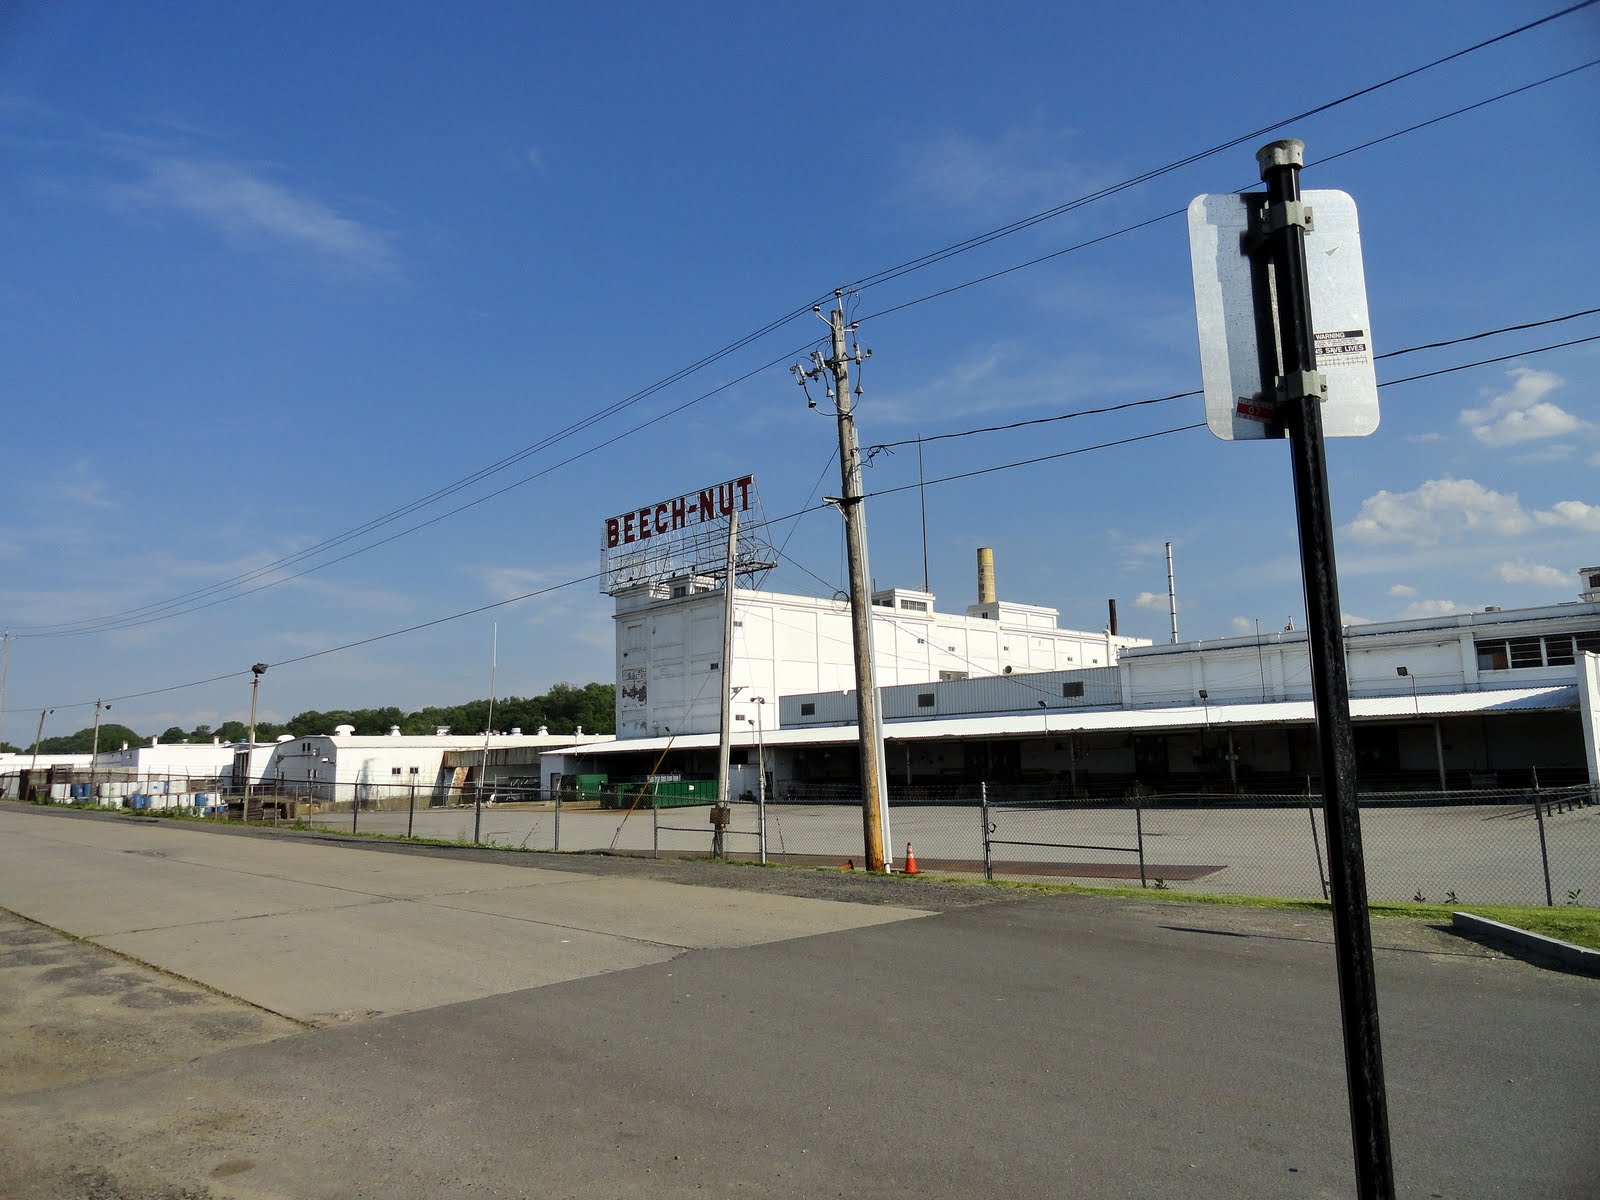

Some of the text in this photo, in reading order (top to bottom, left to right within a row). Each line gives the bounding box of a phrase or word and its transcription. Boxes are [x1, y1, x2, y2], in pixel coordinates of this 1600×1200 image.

[1315, 332, 1345, 340] WARNING
[1325, 346, 1343, 354] SAVE
[1344, 344, 1364, 352] LIVES
[607, 476, 752, 548] BEECH-NUT
